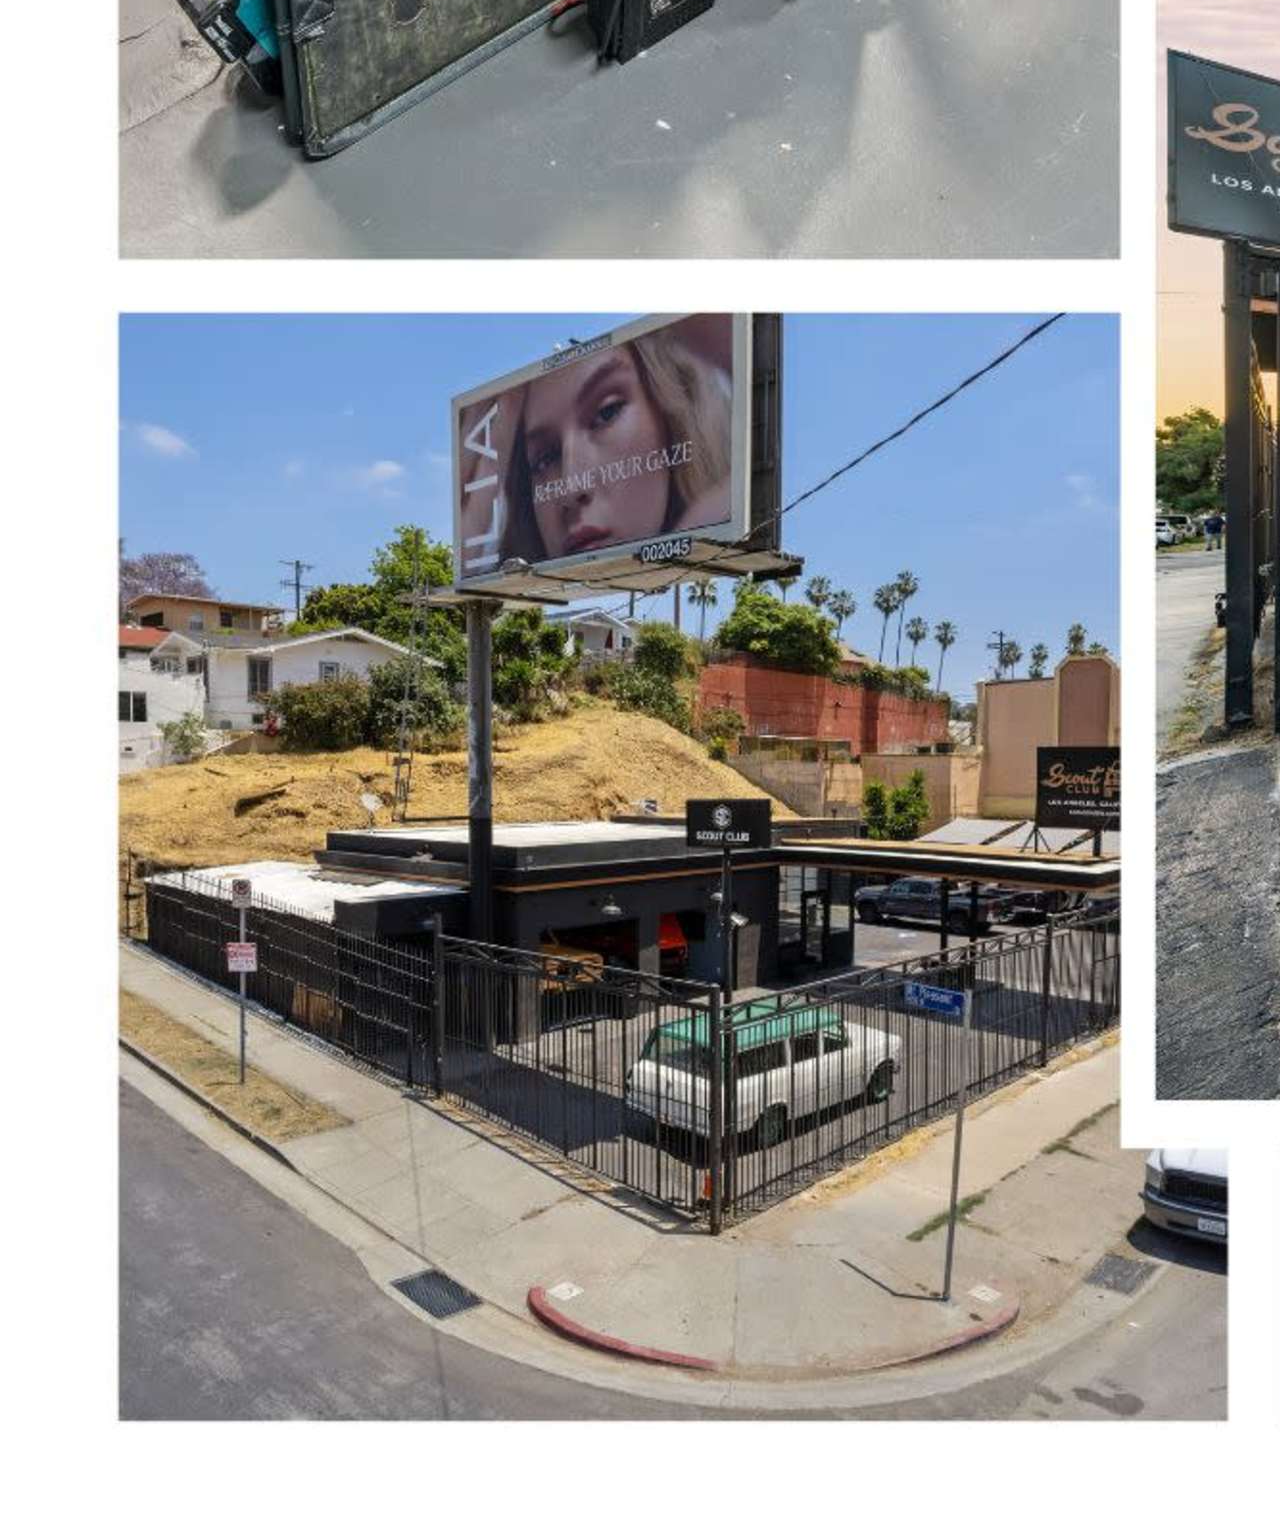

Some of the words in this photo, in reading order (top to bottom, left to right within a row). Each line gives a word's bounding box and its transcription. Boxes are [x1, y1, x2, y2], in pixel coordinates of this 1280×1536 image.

[1211, 173, 1253, 191] LOS
[534, 470, 597, 505] REFRAME
[600, 456, 643, 488] YOUR
[645, 440, 694, 472] GAZE
[641, 539, 690, 561] 002045
[1040, 762, 1105, 788] Scout
[1066, 784, 1099, 795] CLUB
[725, 831, 750, 842] CLUB
